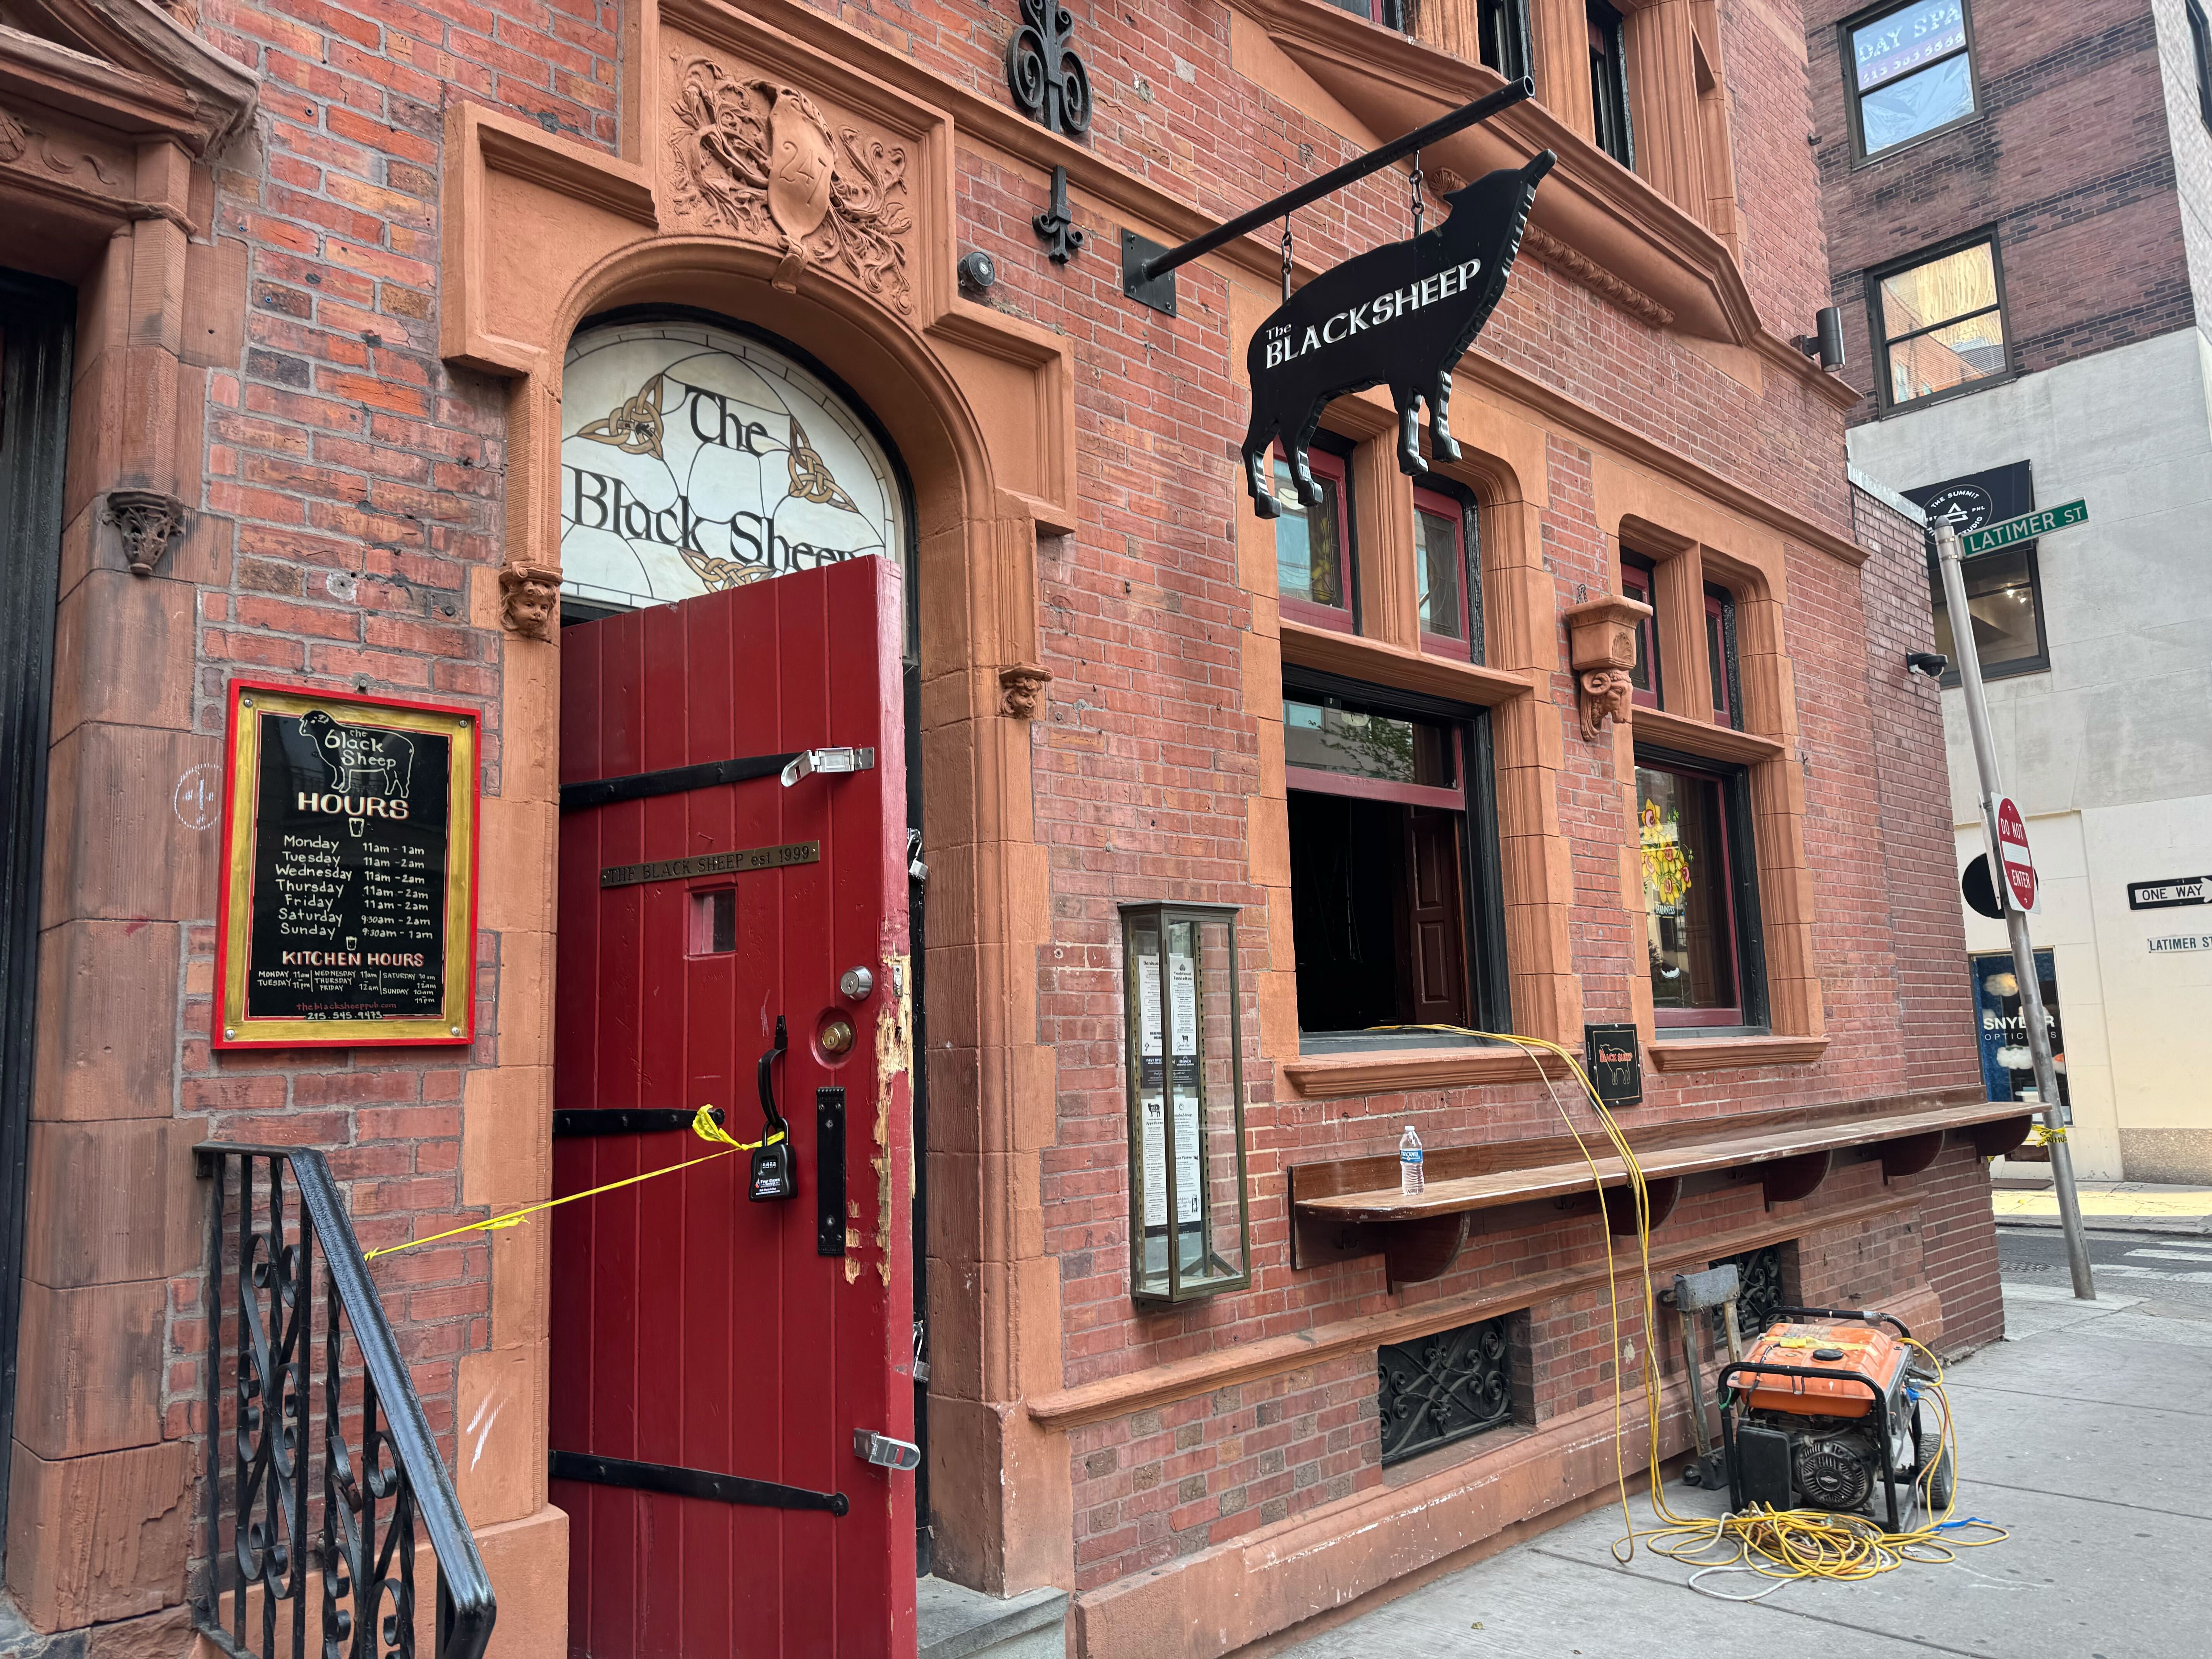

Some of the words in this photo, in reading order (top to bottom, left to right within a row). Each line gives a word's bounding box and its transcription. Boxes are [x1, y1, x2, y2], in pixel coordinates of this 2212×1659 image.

[1859, 25, 1902, 62] DAY
[1914, 3, 1961, 38] SPA
[1266, 321, 1292, 340] The
[685, 383, 769, 457] The
[1930, 496, 1946, 508] THE
[1948, 490, 1980, 500] SUMMIT
[572, 468, 706, 557] Black
[1961, 516, 1983, 534] TUDIO
[1969, 512, 2056, 552] LATIMER
[2064, 506, 2083, 523] ST
[350, 729, 368, 737] the
[341, 749, 396, 770] Sheep
[298, 792, 409, 819] HOURS
[2000, 818, 2010, 836] DO
[2011, 821, 2023, 840] NOT
[284, 835, 339, 854] Monday
[362, 842, 390, 853] 11am
[282, 851, 341, 867] Tuesday
[363, 857, 390, 867] 11am
[608, 866, 634, 884] THE
[643, 860, 692, 880] BLACK
[697, 854, 744, 873] SHEEP
[778, 845, 809, 863] 1999
[275, 864, 352, 881] Wednesday
[364, 871, 391, 882] 11am
[2011, 869, 2031, 889] ENTER
[275, 879, 344, 898] Thursday
[363, 885, 393, 897] 11am
[2142, 888, 2168, 901] ONE
[2176, 884, 2203, 898] WAY
[285, 894, 333, 912] Friday
[364, 900, 394, 910] 11am
[278, 908, 342, 927] Saturday
[361, 915, 395, 924] 9:30am
[280, 922, 336, 940] Sunday
[362, 927, 397, 938] 9:30am
[2149, 937, 2197, 951] LATIMER
[282, 950, 362, 967] KITCHEN
[367, 952, 424, 967] HOURS
[314, 970, 356, 978] WEDNESDAY
[383, 972, 416, 981] SATURDAY
[257, 979, 292, 987] TUESDAY
[292, 982, 310, 990] 11pm
[383, 988, 409, 996] SUNDAY
[1983, 1015, 2055, 1030] SNYDR
[1984, 1031, 2057, 1041] OPTICS
